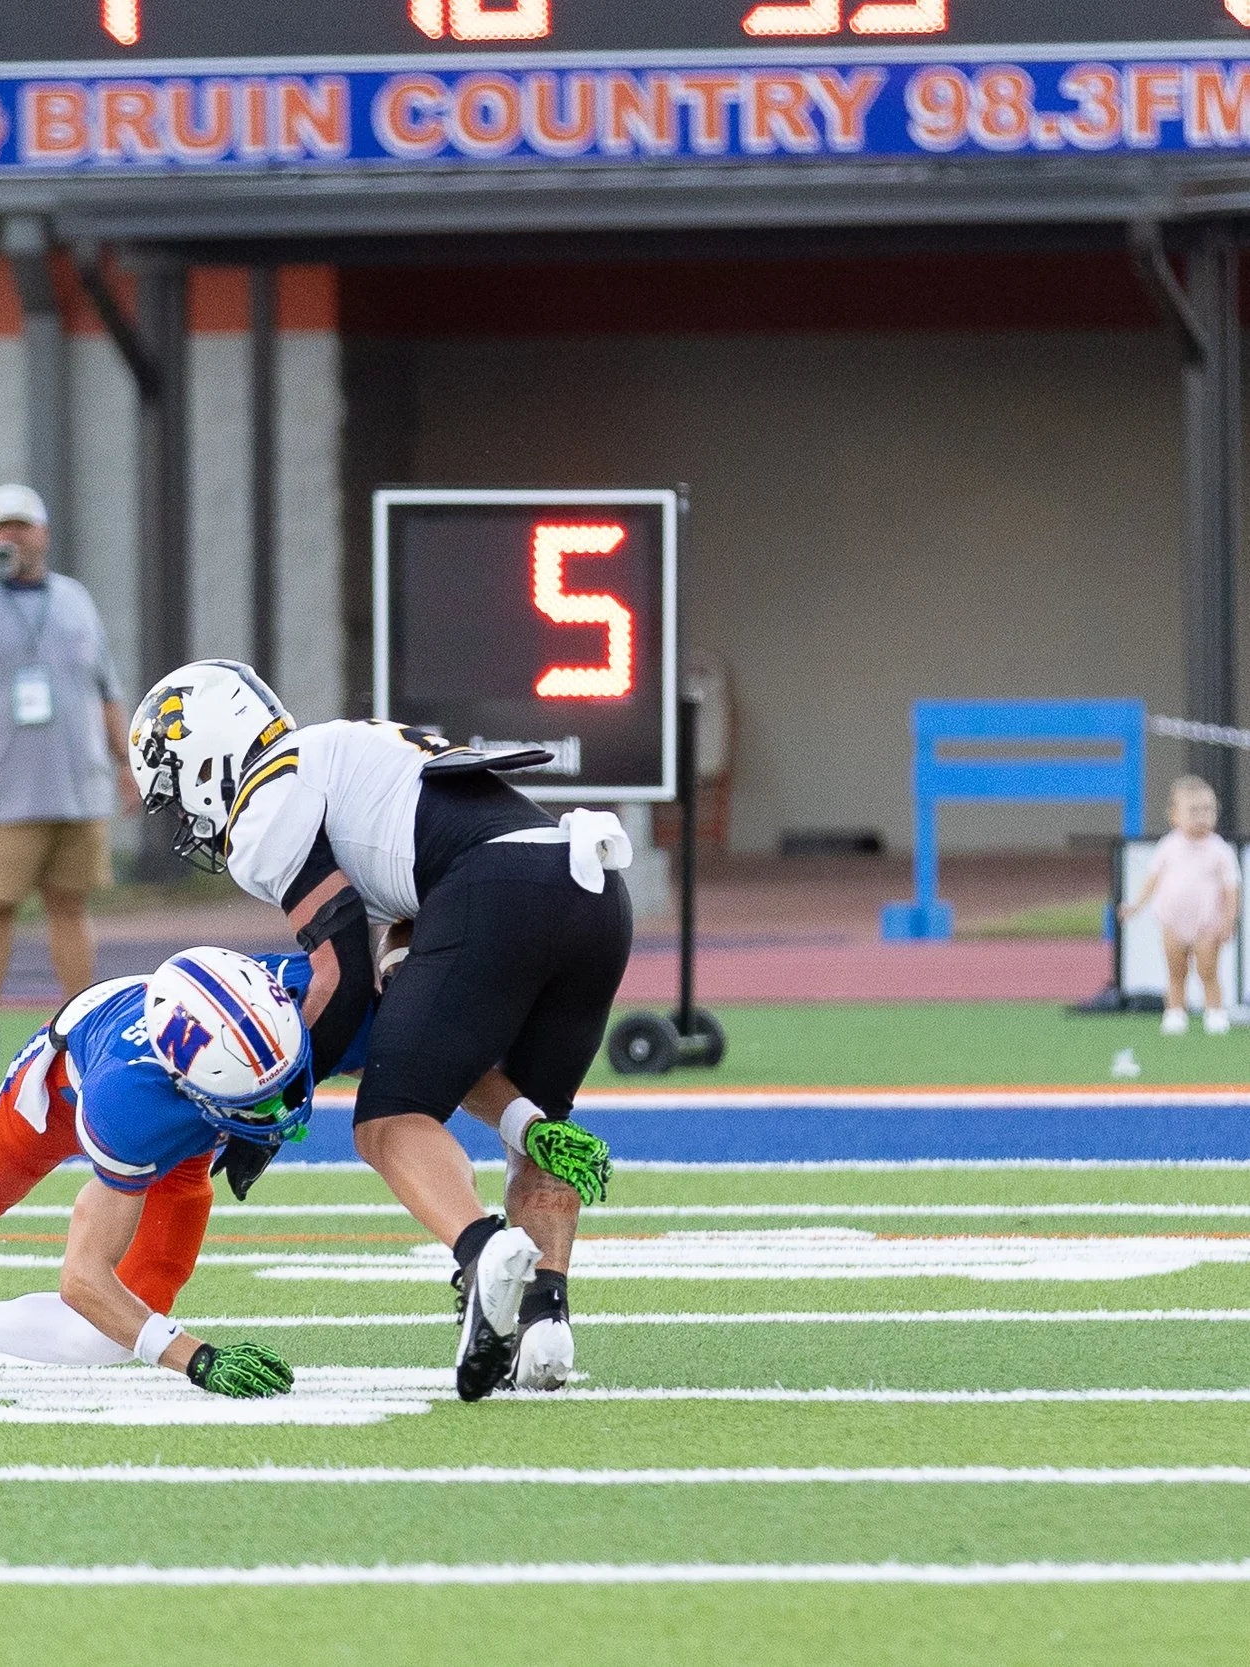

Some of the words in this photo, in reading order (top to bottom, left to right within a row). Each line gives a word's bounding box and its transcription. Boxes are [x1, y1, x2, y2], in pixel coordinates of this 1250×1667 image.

[25, 80, 348, 158] BRUIN
[380, 72, 886, 153] COUNTRY
[910, 67, 1250, 145] 98.3FM
[534, 524, 632, 698] 5
[156, 1002, 214, 1077] N
[258, 1059, 290, 1086] Riddell
